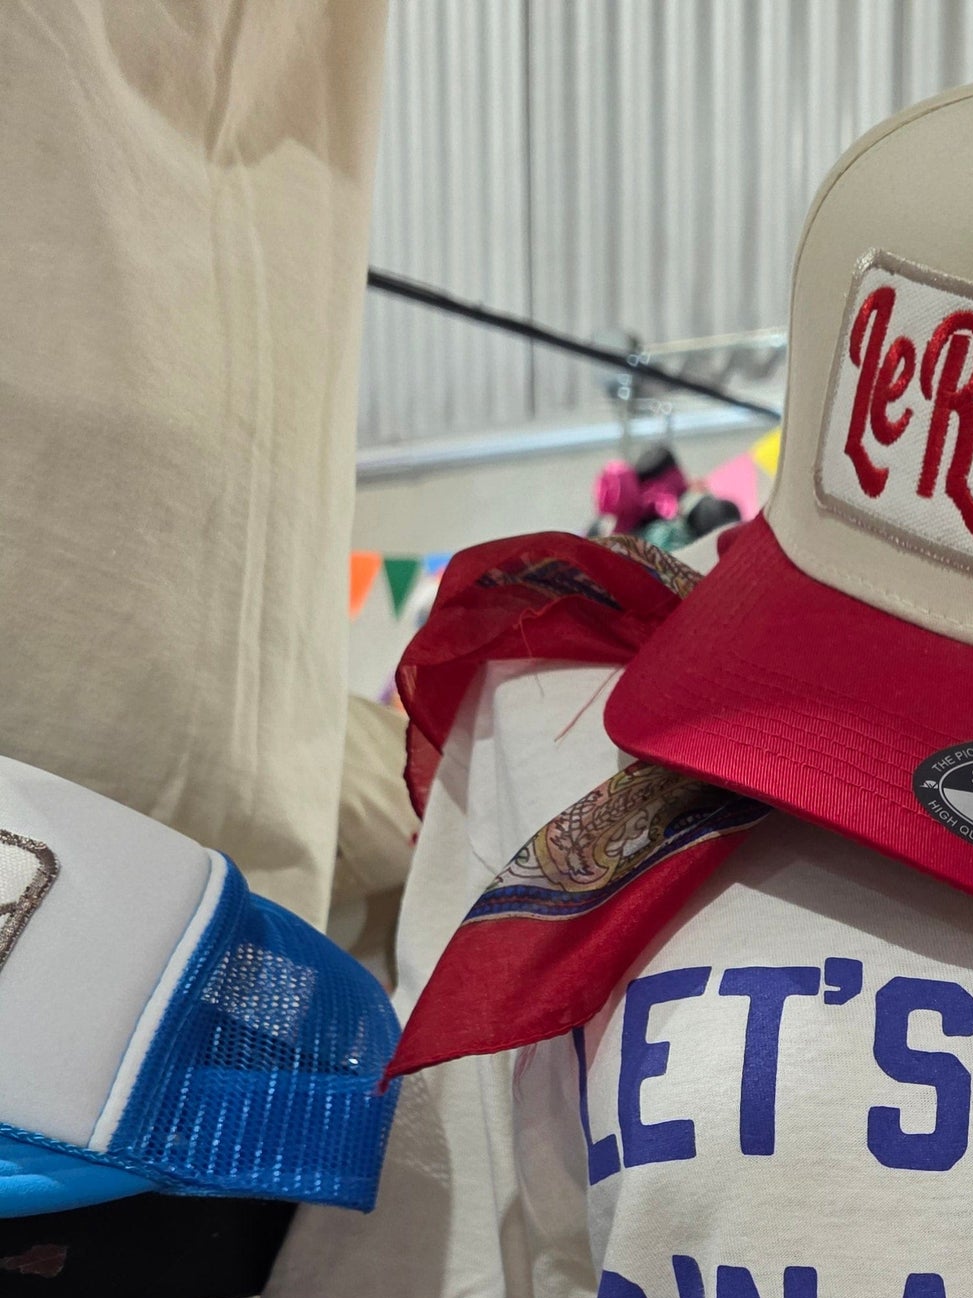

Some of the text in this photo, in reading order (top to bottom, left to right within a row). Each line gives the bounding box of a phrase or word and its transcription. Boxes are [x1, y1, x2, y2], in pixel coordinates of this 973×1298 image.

[843, 285, 917, 498] Le
[931, 755, 955, 773] THE
[927, 800, 956, 828] HIGH
